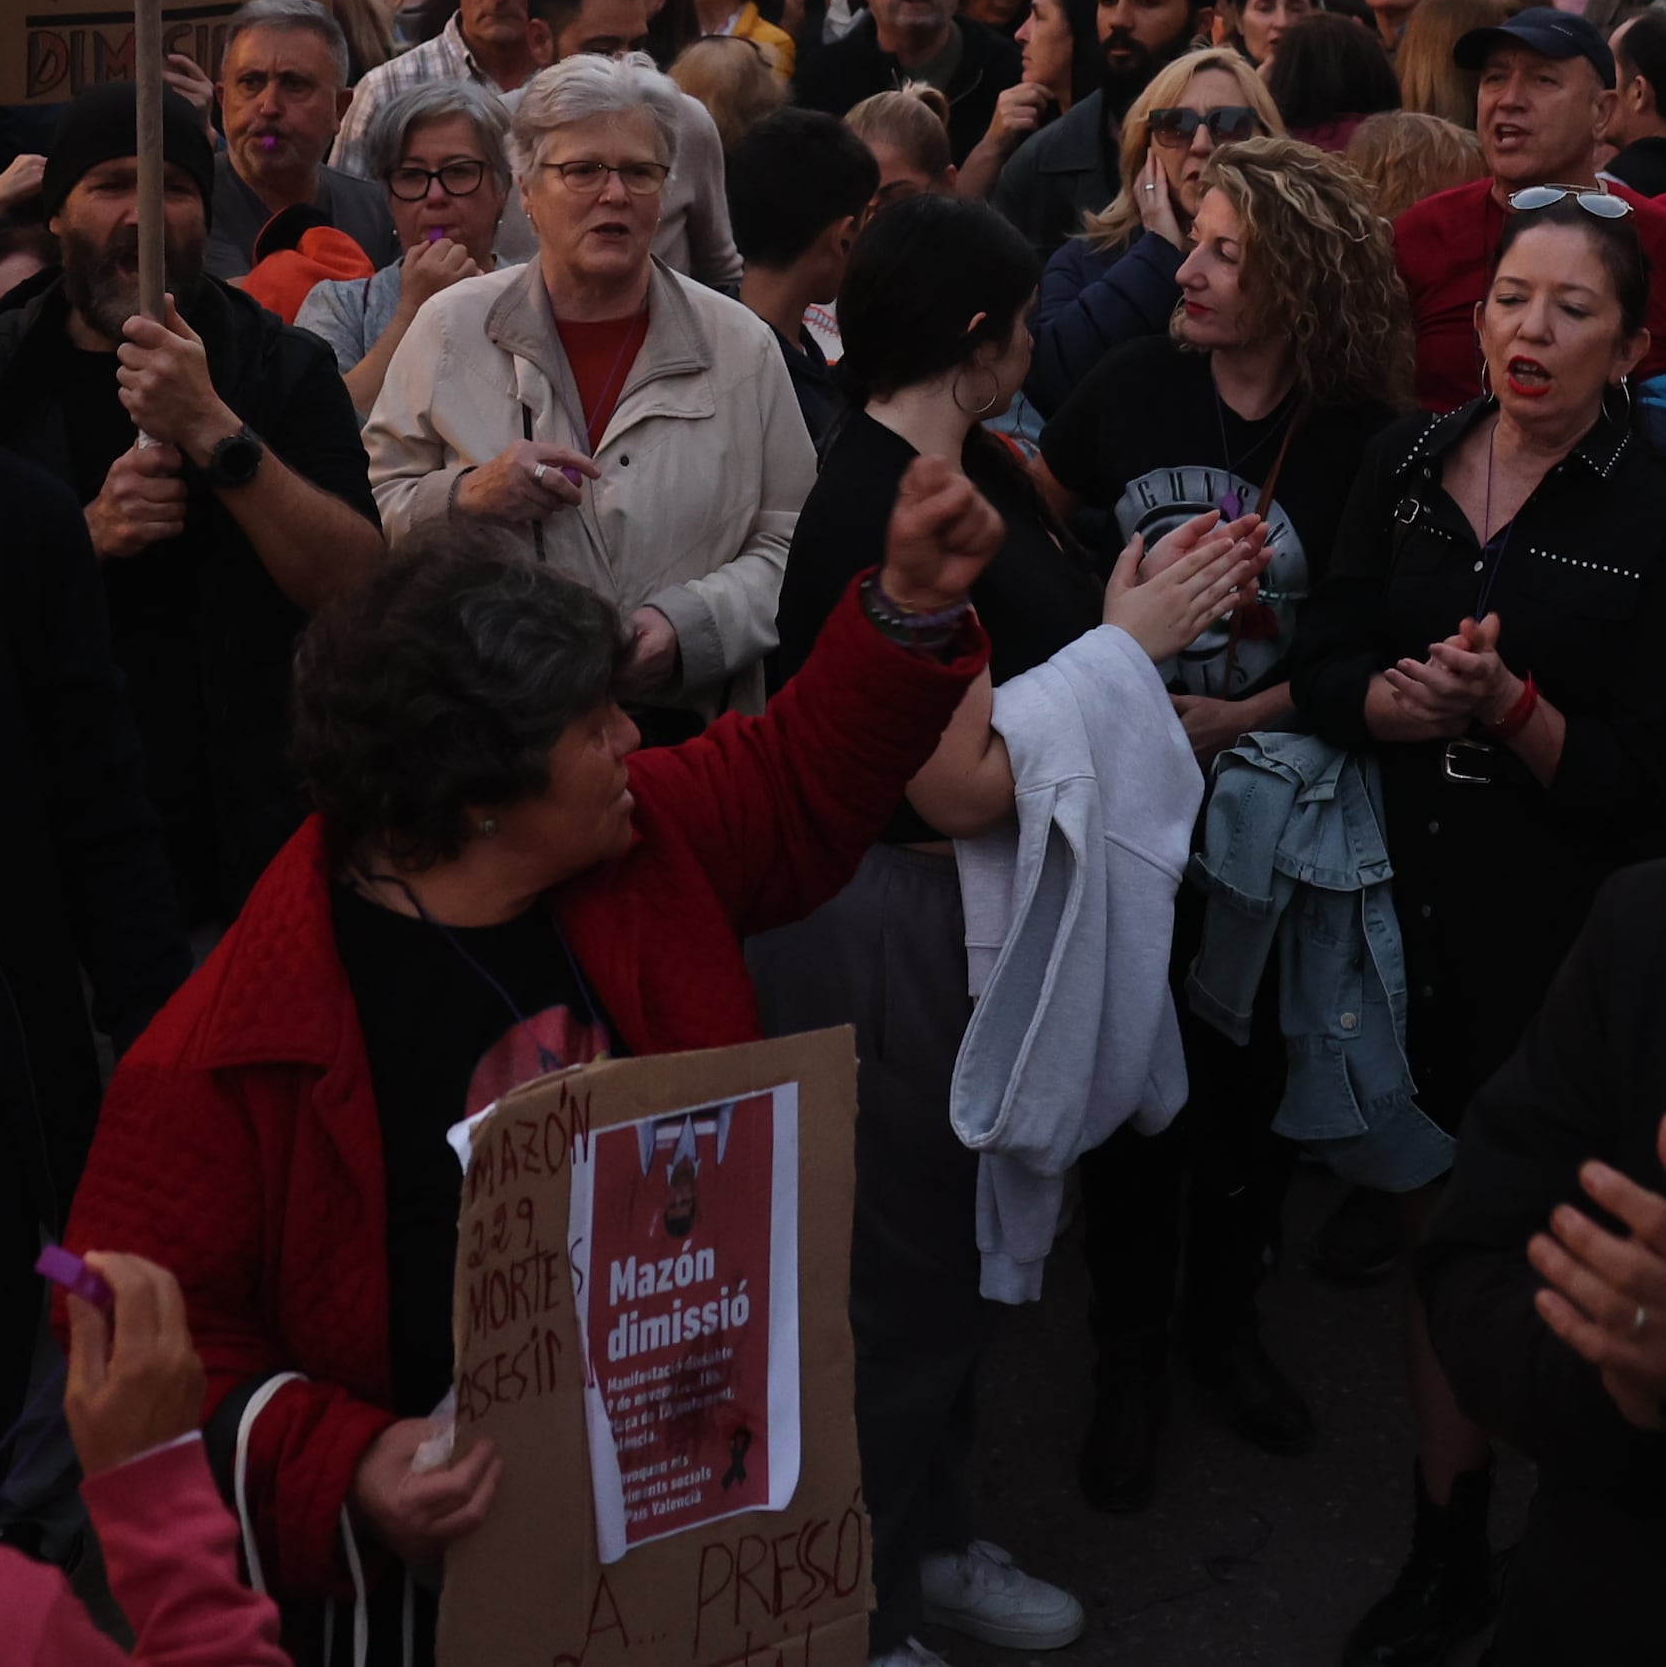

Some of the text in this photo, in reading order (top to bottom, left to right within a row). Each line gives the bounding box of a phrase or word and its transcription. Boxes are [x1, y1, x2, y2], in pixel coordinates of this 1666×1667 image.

[470, 1080, 592, 1204] MAZÓN
[467, 1197, 534, 1269] 229
[609, 1239, 717, 1308] Mazón
[606, 1279, 751, 1364] dimissió
[616, 1396, 632, 1411] de
[652, 1487, 702, 1516] Valencià
